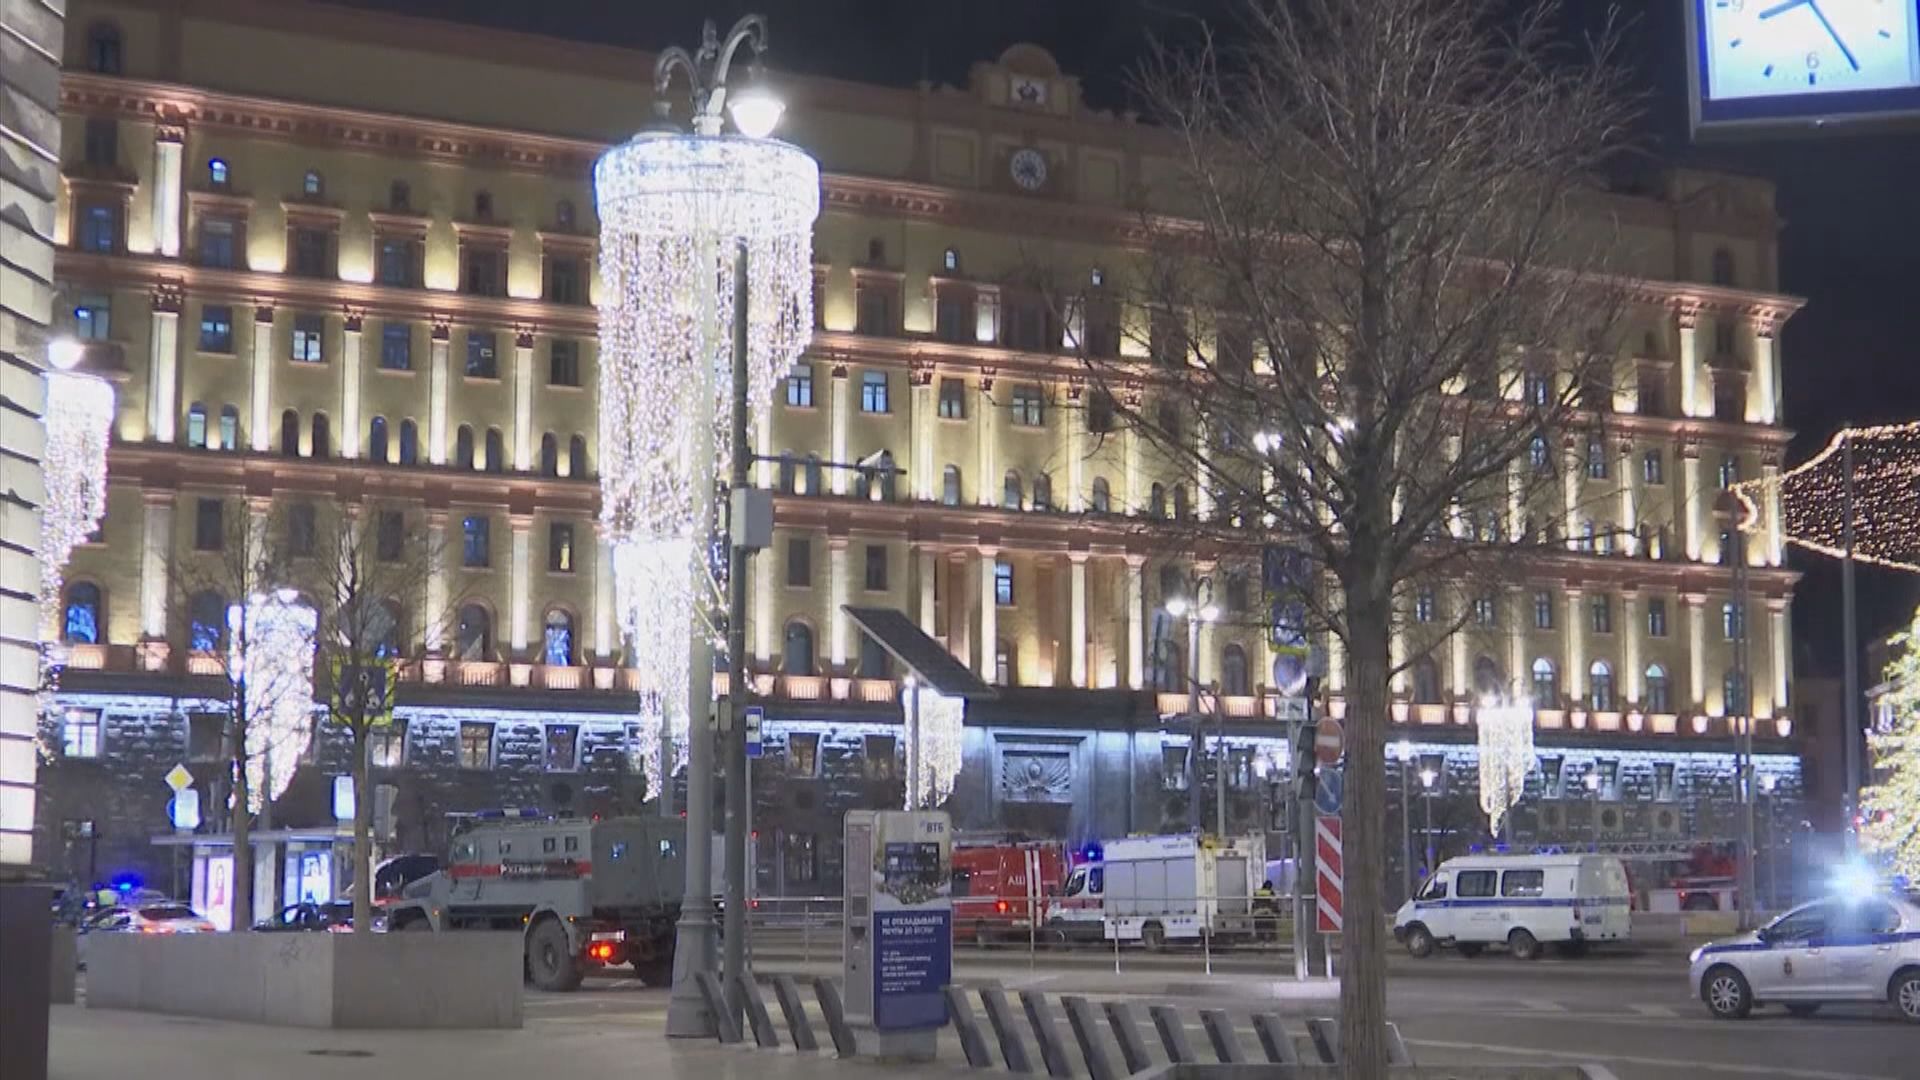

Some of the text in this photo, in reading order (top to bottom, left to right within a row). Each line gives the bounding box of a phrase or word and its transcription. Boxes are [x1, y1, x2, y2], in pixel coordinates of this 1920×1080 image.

[1806, 51, 1820, 69] 6
[927, 822, 944, 833] ВТБ
[1007, 875, 1026, 886] АШ
[881, 916, 944, 926] НЕ ОТКЛАДЫВАЙТЕ
